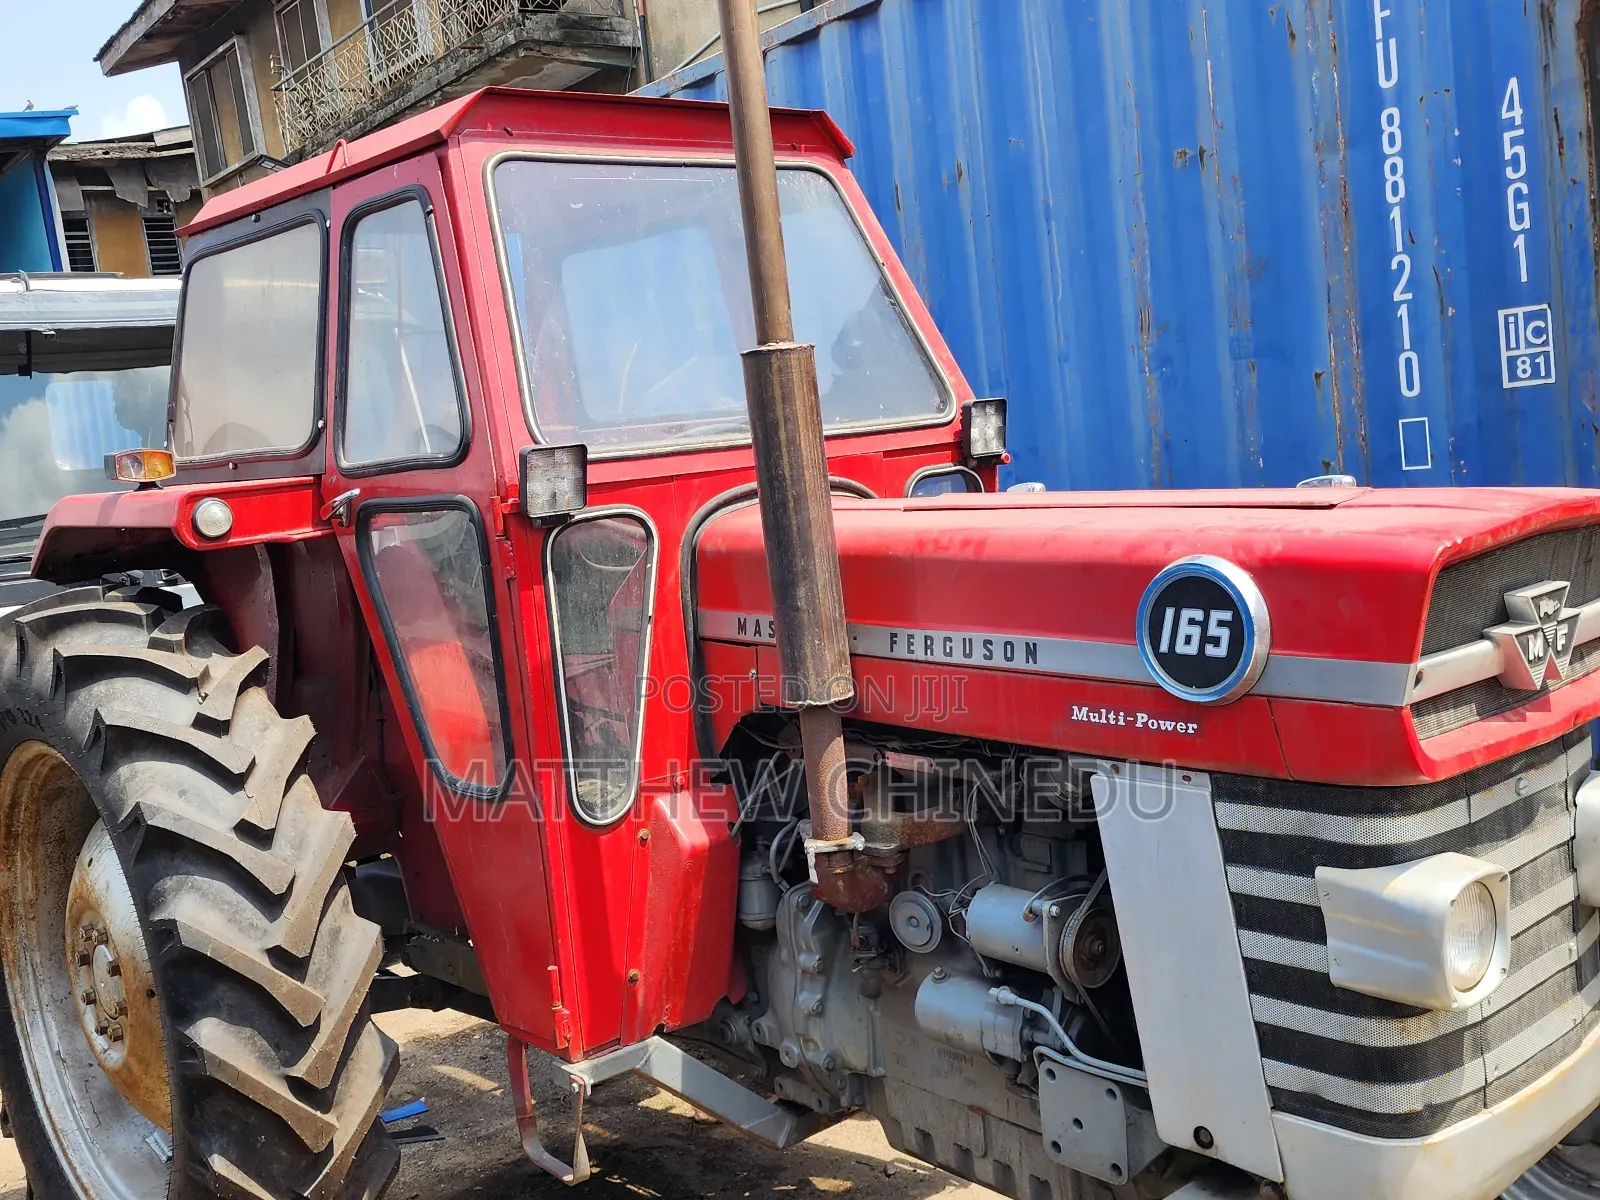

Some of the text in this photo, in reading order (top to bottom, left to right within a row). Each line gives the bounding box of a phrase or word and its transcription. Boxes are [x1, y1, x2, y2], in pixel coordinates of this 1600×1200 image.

[1373, 0, 1420, 399] FU 881210
[1501, 77, 1531, 283] 45G1
[889, 632, 1038, 665] FERGUSON
[1159, 606, 1233, 658] 165
[1072, 706, 1198, 734] Multi-Power
